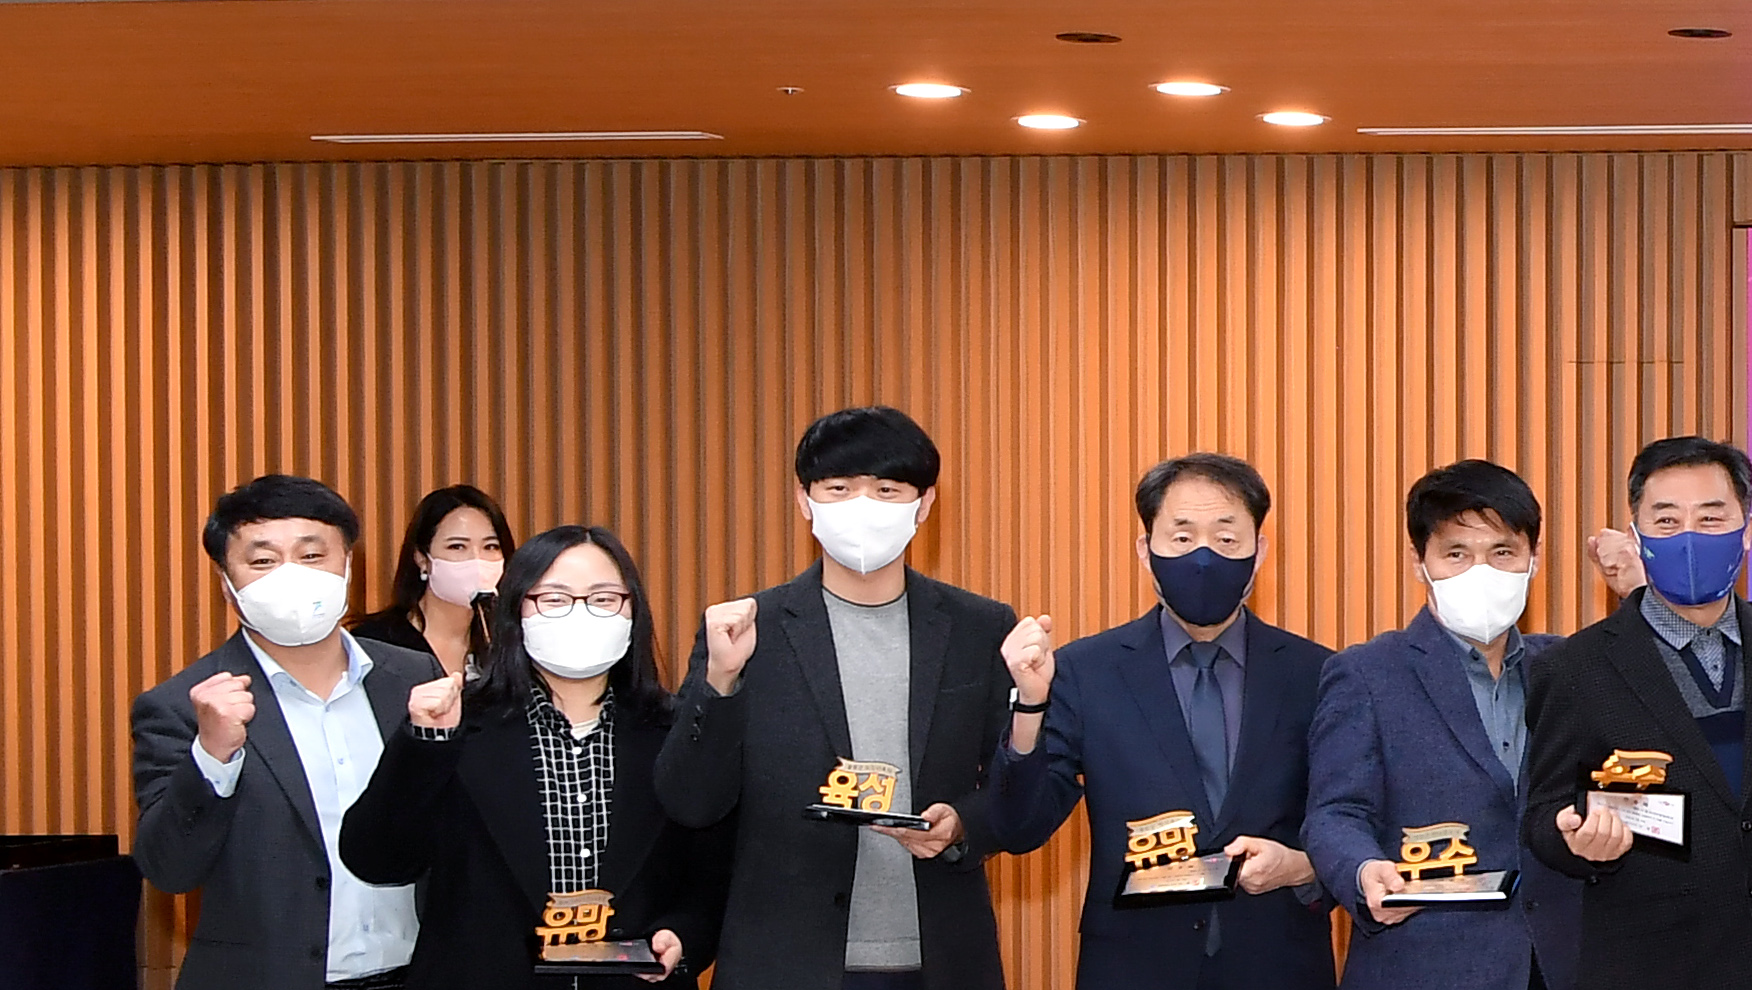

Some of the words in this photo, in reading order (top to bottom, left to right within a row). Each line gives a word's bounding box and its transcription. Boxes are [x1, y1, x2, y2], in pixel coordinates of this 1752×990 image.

[819, 770, 896, 813] 육성
[1125, 825, 1199, 870] 유망
[1396, 838, 1477, 880] 우수
[535, 900, 615, 946] 유망
